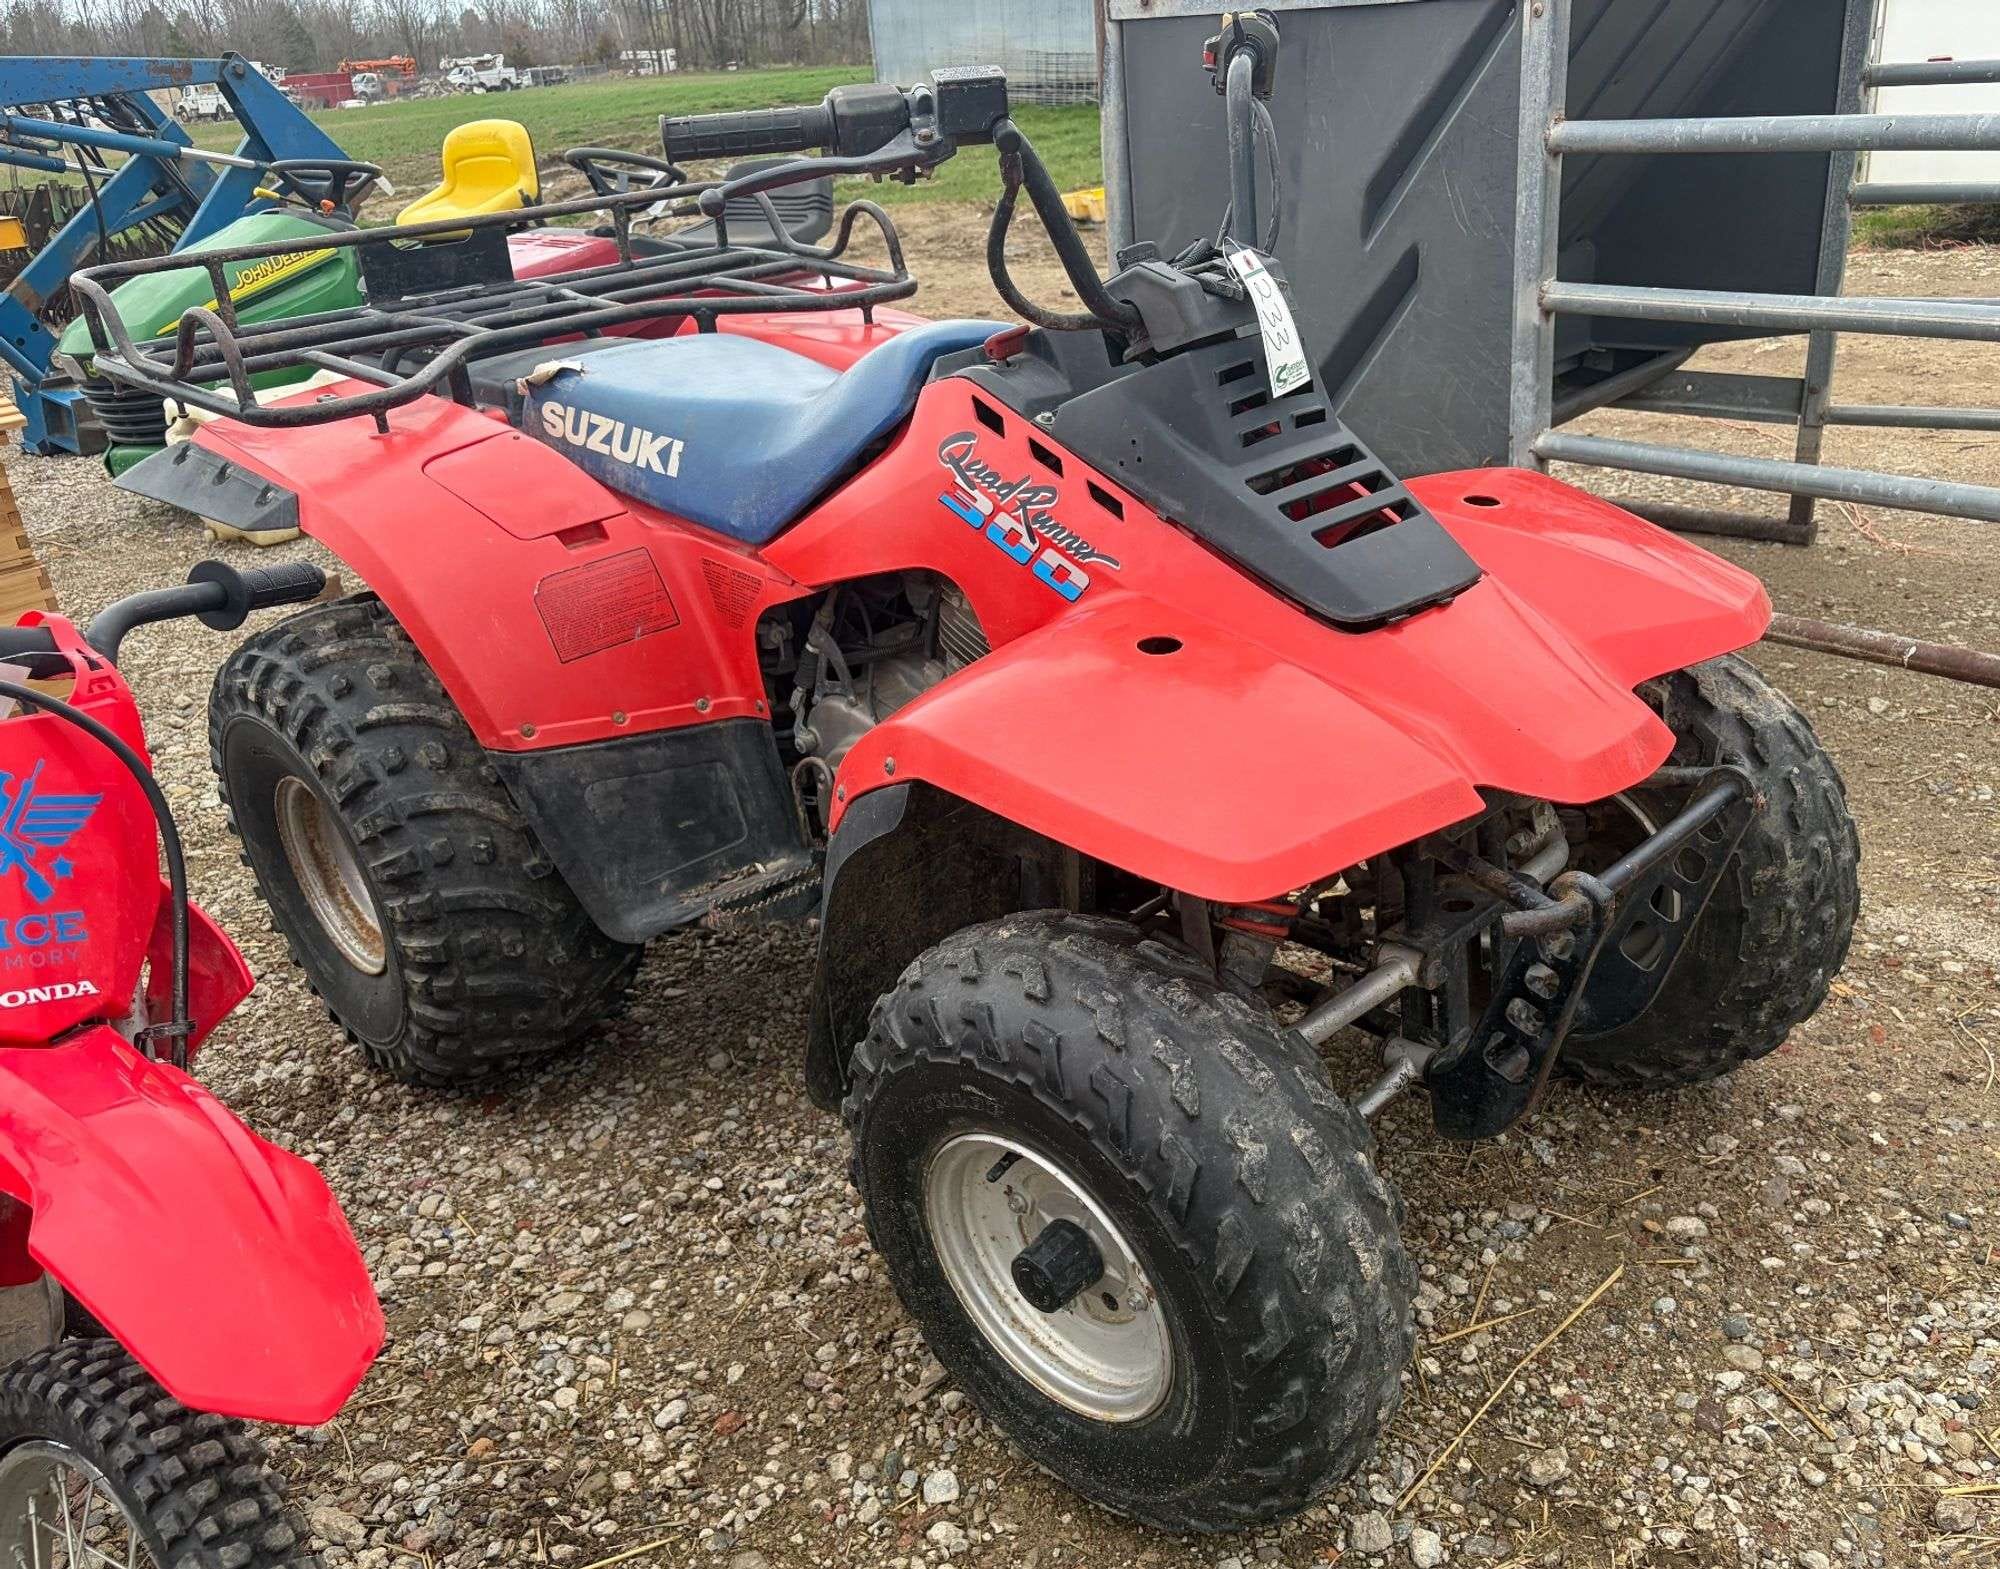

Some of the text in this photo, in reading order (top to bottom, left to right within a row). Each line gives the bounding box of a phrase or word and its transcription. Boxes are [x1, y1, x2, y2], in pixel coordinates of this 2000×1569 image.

[235, 260, 274, 289] JOHN
[541, 401, 685, 478] SUZUKI
[938, 478, 1091, 603] 300
